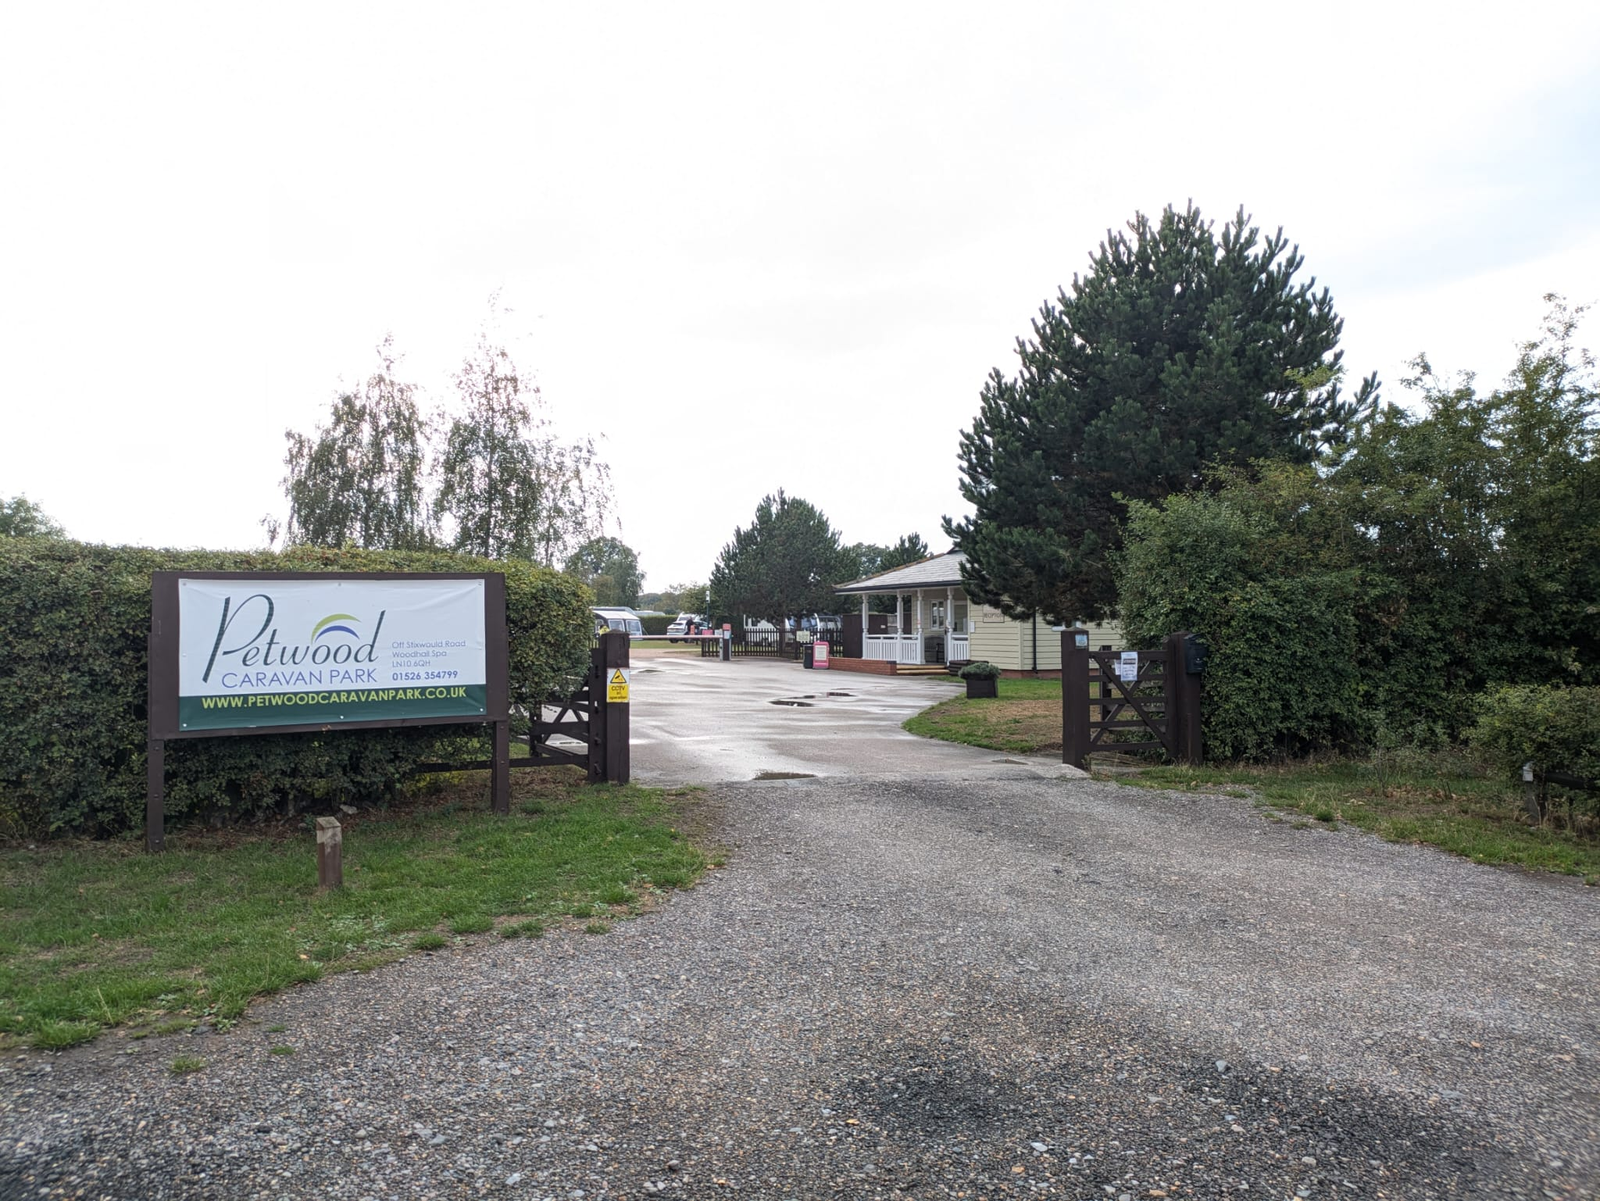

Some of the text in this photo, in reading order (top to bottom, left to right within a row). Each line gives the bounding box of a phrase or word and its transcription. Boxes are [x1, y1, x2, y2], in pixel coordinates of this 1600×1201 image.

[202, 594, 386, 683] Petwood
[392, 641, 404, 649] Off
[392, 650, 447, 658] Woodhall Spa
[392, 659, 431, 668] LN10 6QH
[221, 668, 378, 689] CARAVAN PARK
[392, 670, 458, 681] 01526 354799
[202, 687, 466, 709] WWW.PETWOODCARAVANPARK.CO.UK
